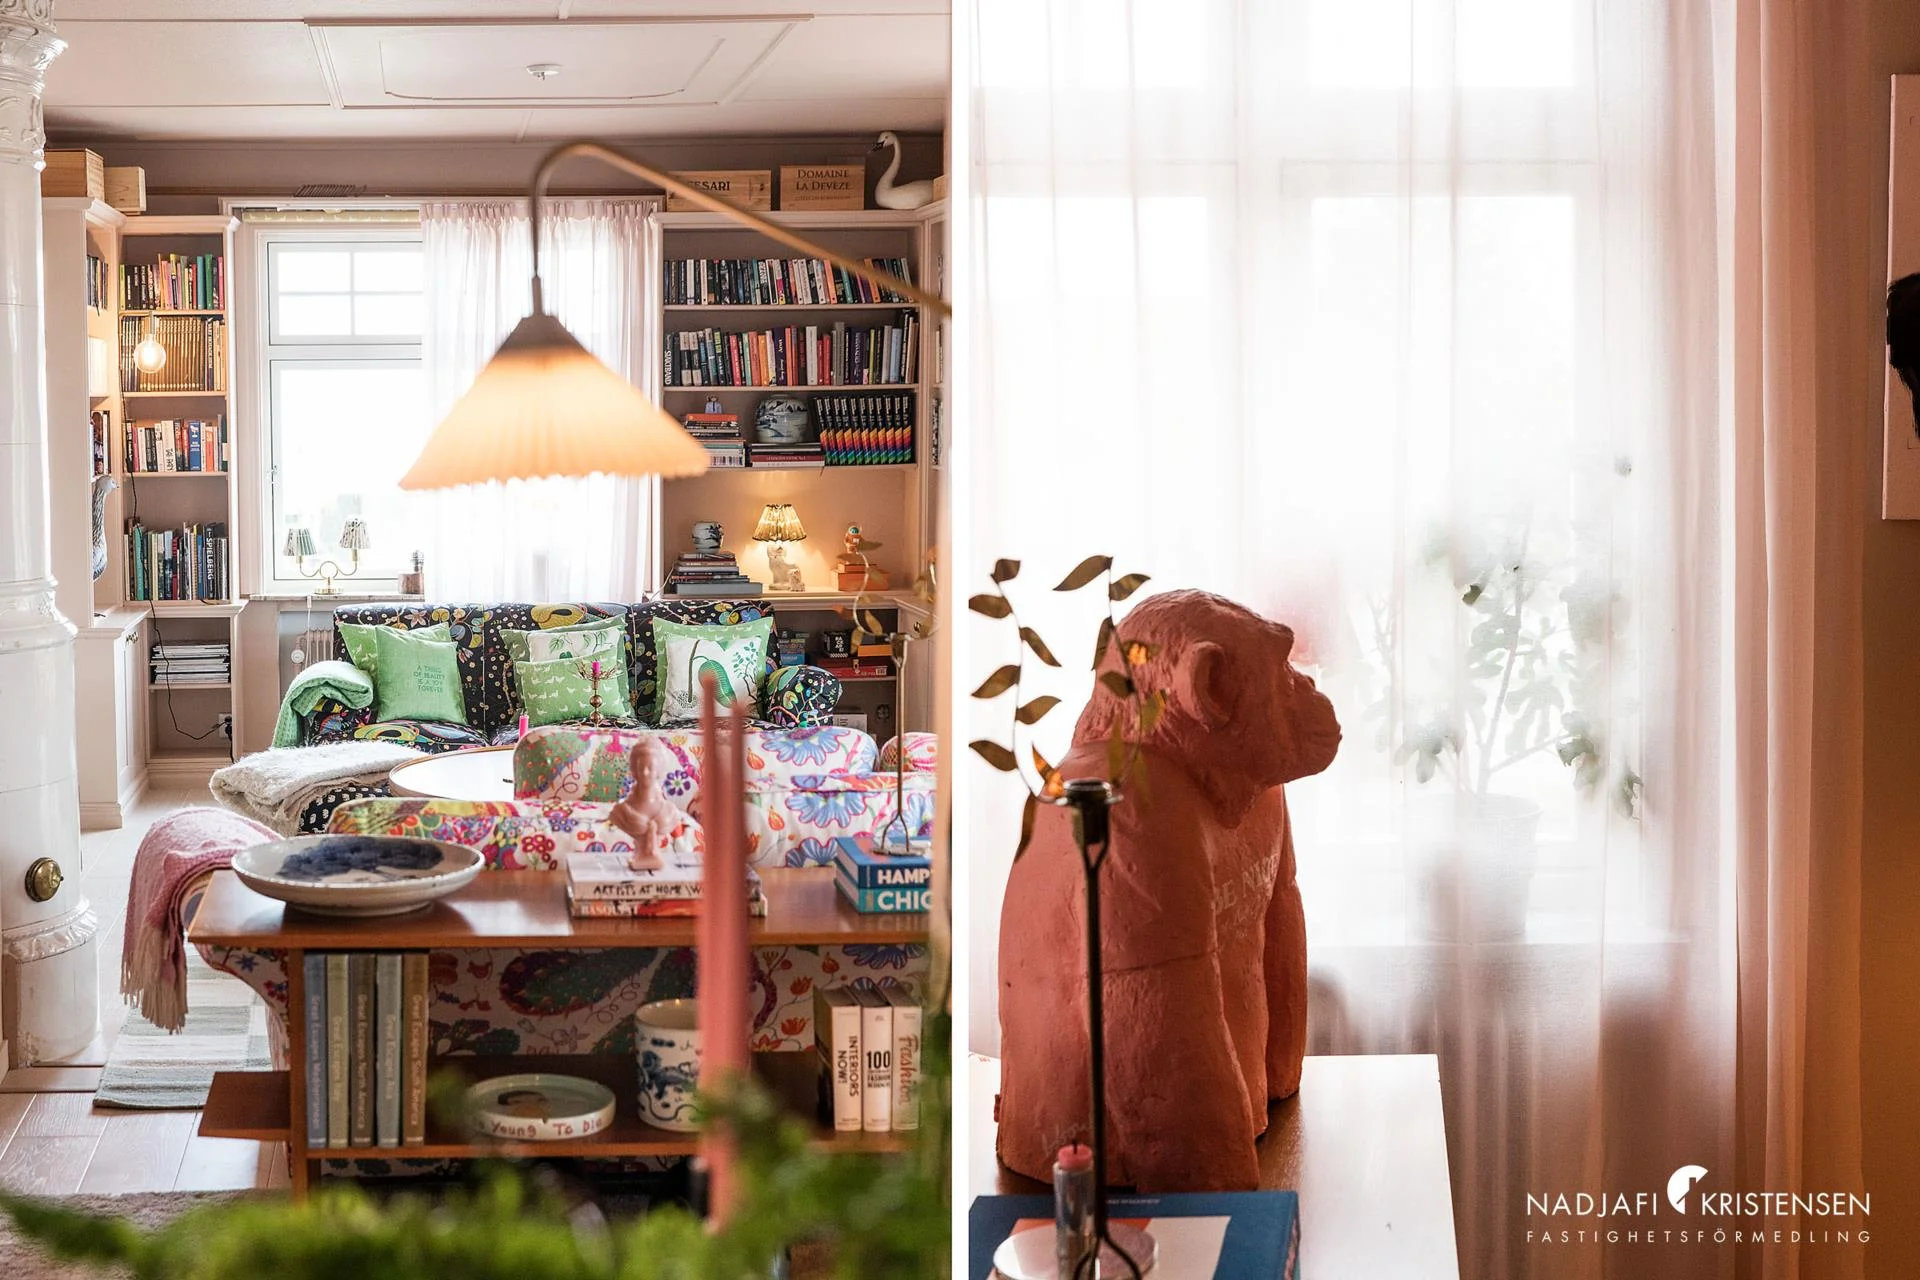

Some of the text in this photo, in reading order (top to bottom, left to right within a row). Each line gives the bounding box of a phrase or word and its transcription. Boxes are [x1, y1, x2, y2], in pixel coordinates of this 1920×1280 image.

[797, 169, 849, 179] DOMAINE
[796, 181, 809, 191] LA
[206, 538, 214, 580] SPIELBERG
[878, 868, 931, 884] HAMP
[593, 885, 636, 896] ARTISTS
[640, 884, 653, 894] AT
[656, 884, 681, 894] HOME
[837, 1050, 848, 1084] NOW!
[848, 1036, 859, 1097] INTERIORS
[867, 1050, 891, 1069] 100
[899, 1034, 919, 1105] Fashion
[491, 1121, 537, 1138] Young
[553, 1122, 574, 1136] To
